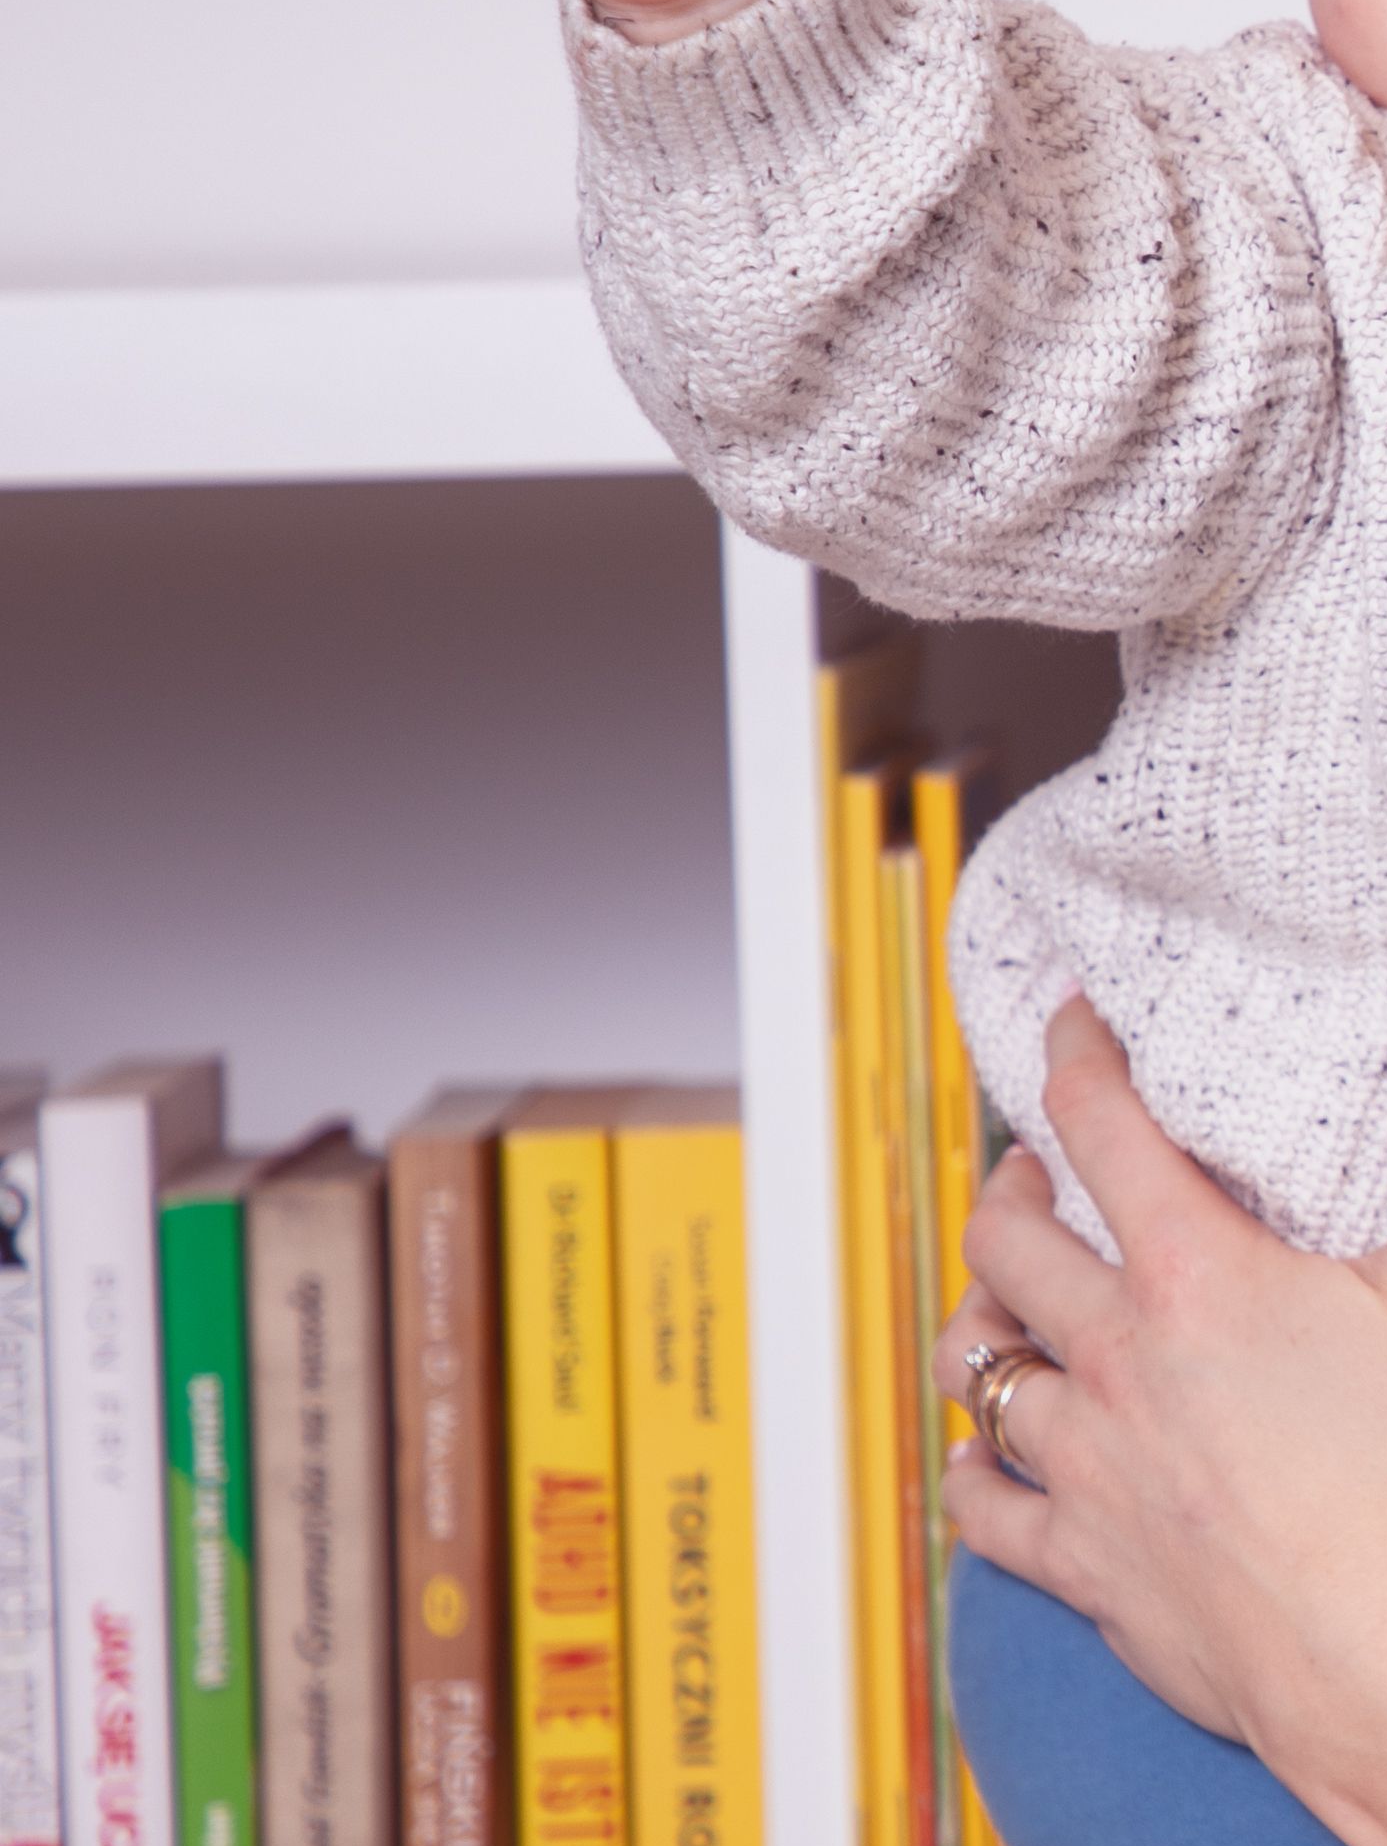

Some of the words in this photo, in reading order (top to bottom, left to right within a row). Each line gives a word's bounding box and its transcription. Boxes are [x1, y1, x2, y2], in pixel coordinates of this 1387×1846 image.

[85, 1264, 127, 1375] RON
[93, 1395, 128, 1492] FRY
[533, 1468, 615, 1614] ADHD
[92, 1601, 143, 1696] JAK
[666, 1471, 717, 1765] TOKSYCZNI
[536, 1642, 617, 1729] NIE
[85, 1702, 140, 1775] SIĘ
